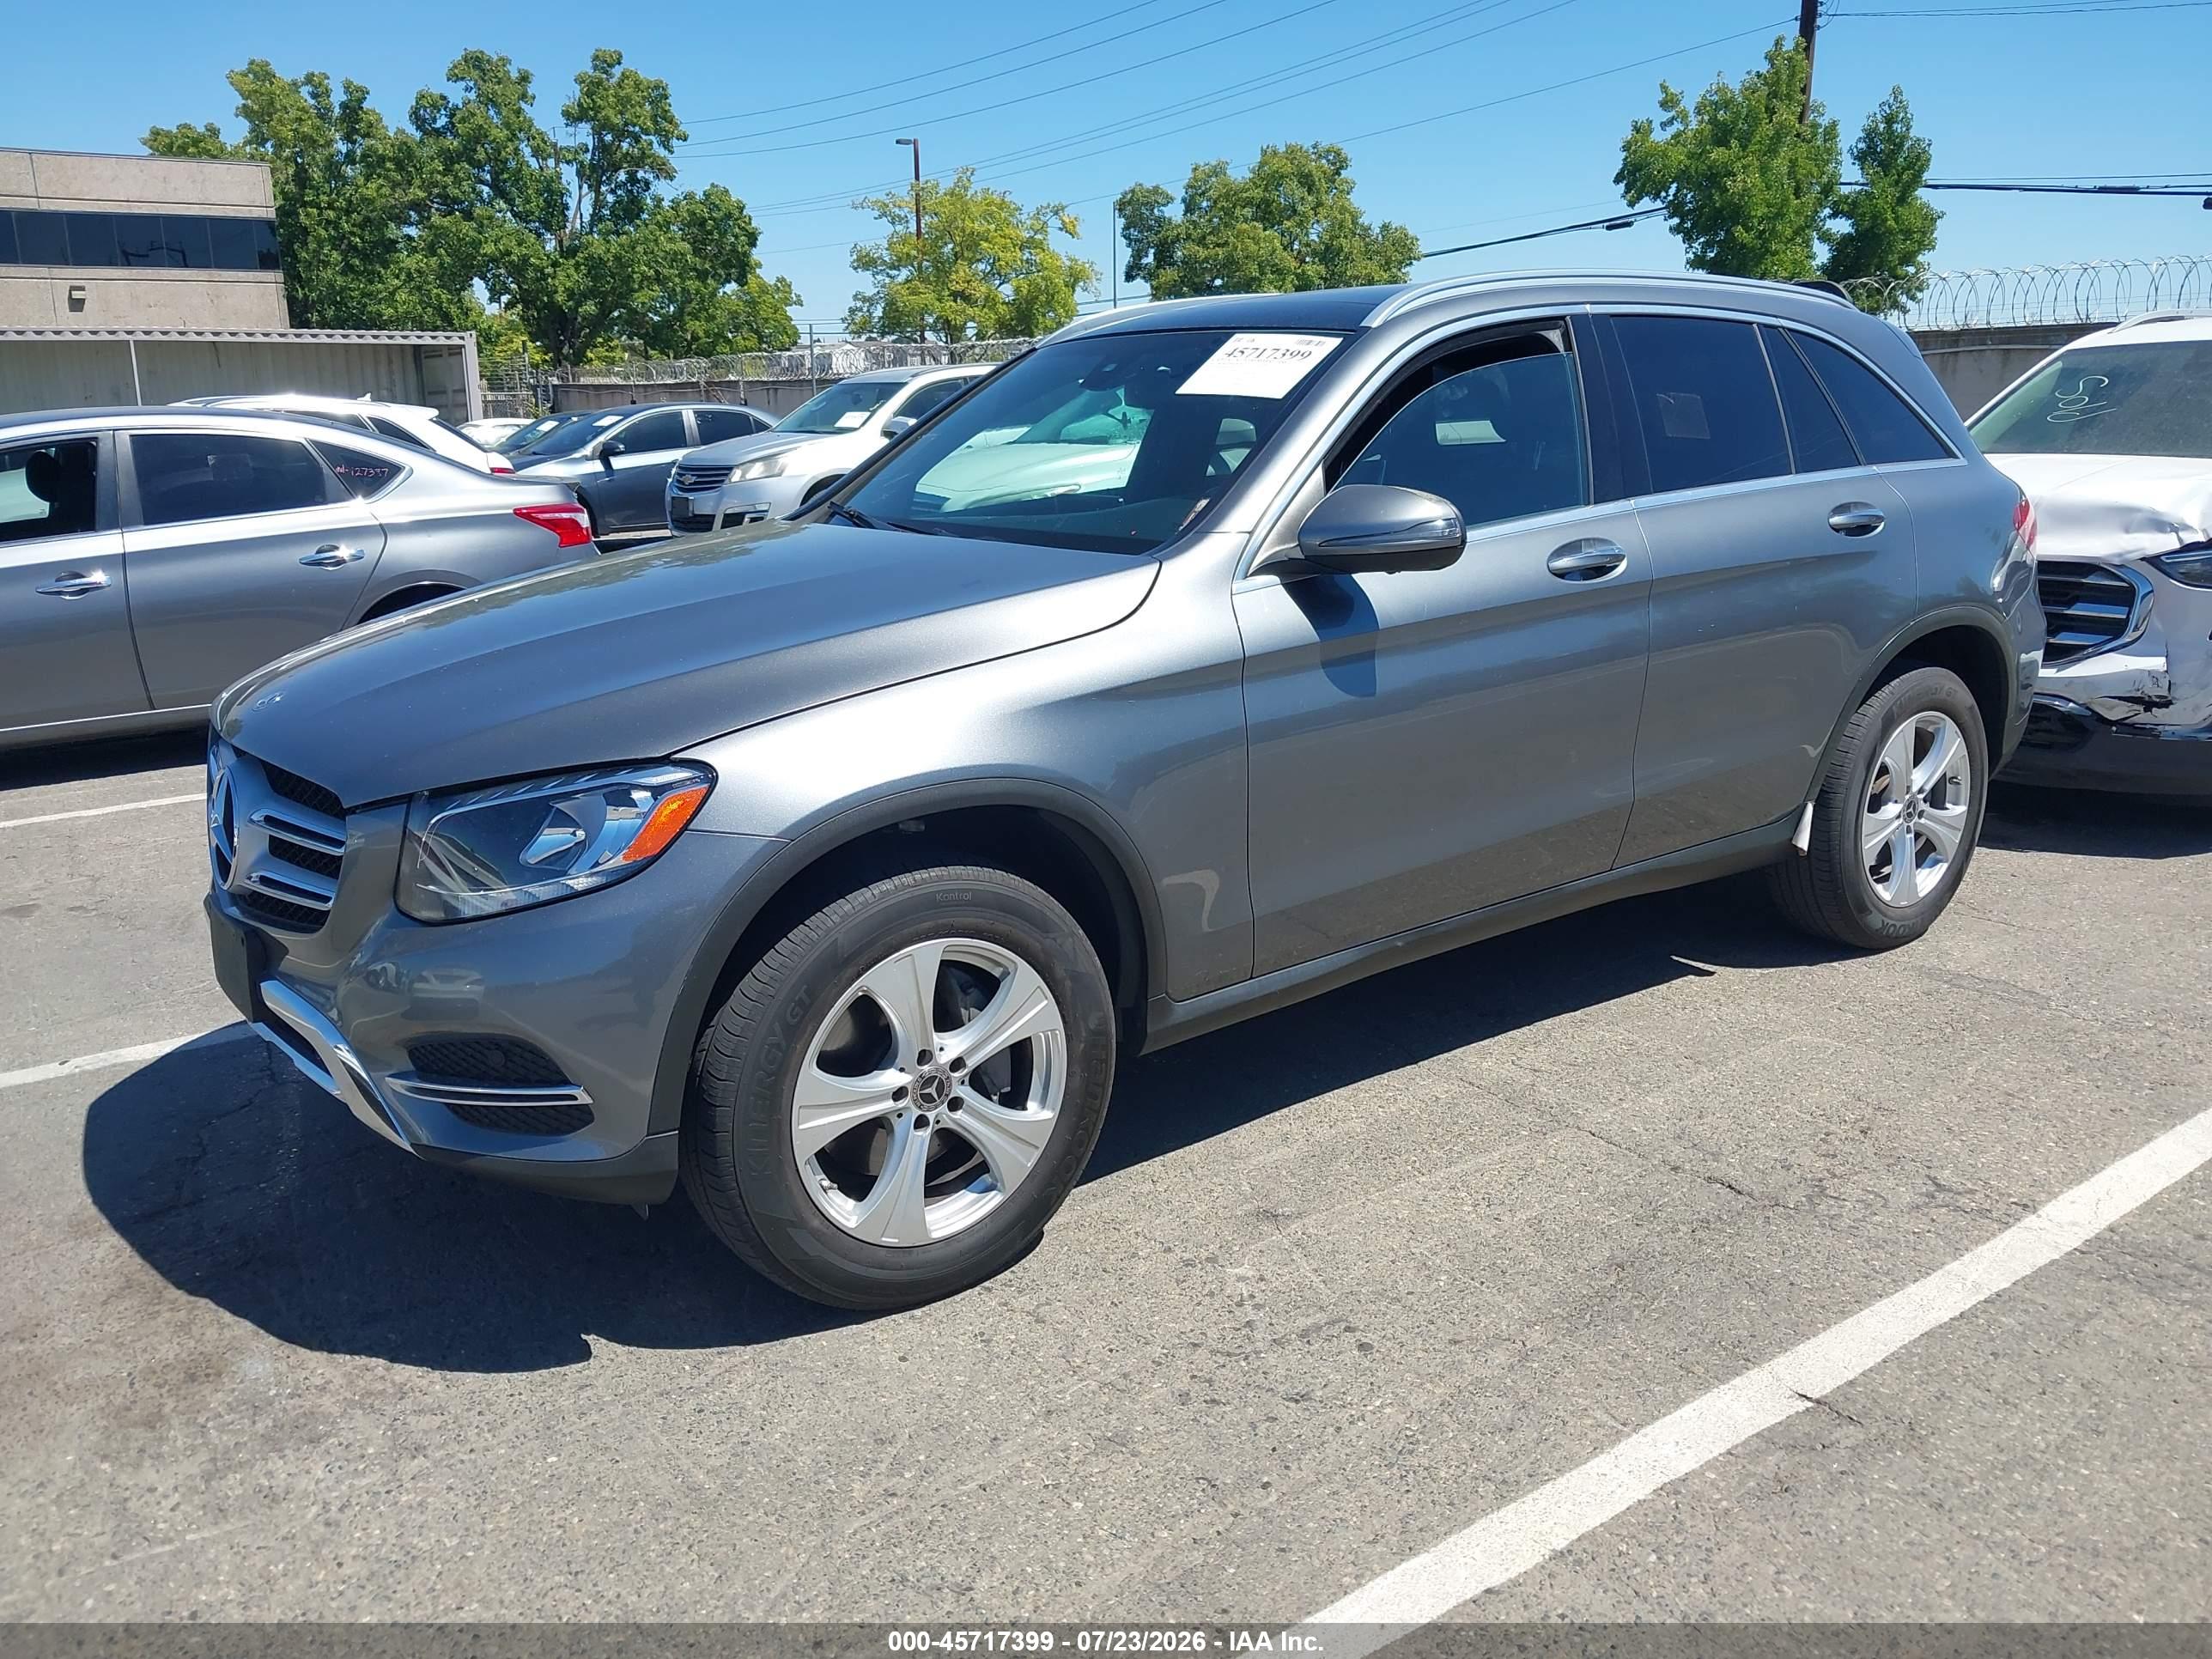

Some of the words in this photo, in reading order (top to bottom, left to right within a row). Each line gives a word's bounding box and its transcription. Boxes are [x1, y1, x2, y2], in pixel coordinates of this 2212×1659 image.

[1224, 347, 1312, 362] 45717399
[935, 891, 972, 902] Kontrol
[787, 984, 811, 1024] GT
